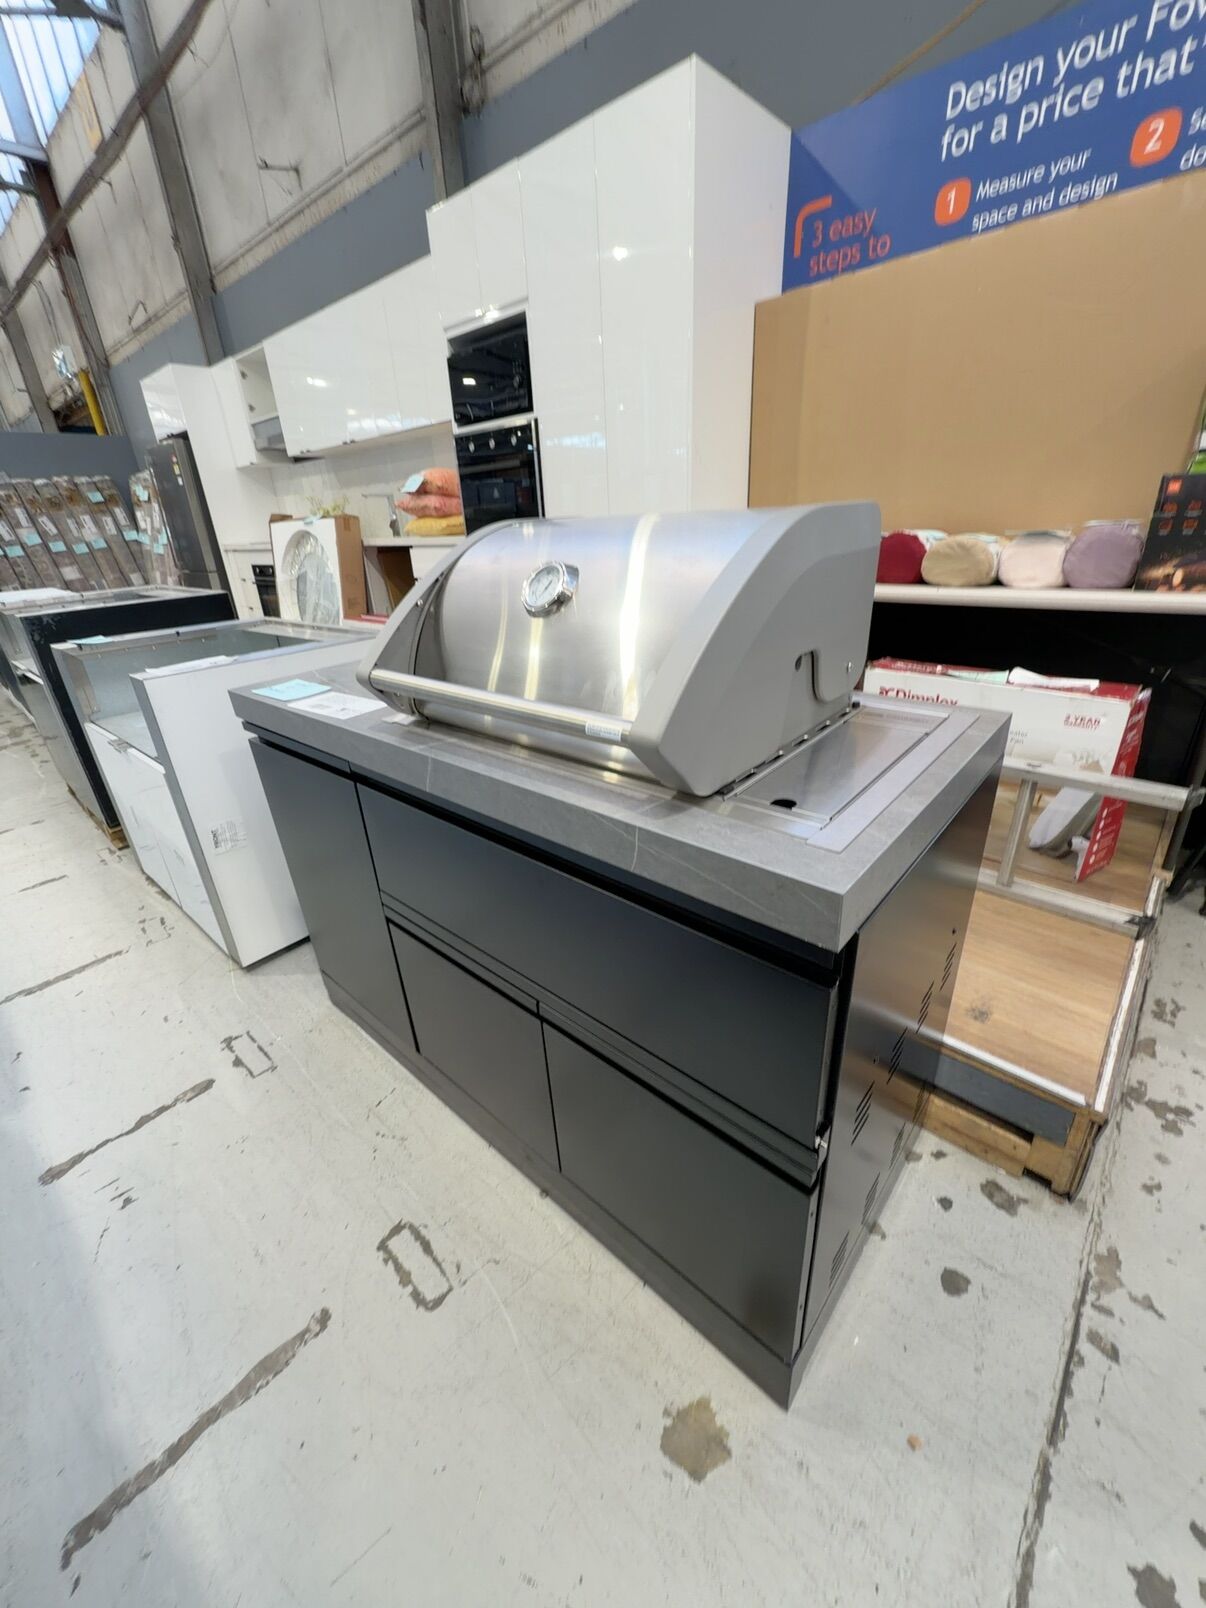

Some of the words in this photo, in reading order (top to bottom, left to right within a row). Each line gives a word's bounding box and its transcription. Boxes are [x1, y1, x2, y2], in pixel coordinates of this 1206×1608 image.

[945, 54, 1043, 120] Design
[1053, 14, 1138, 88] your
[940, 123, 982, 163] for
[990, 115, 1008, 144] a
[1017, 77, 1105, 144] price
[1116, 34, 1198, 99] that
[1143, 117, 1165, 155] 2
[976, 161, 1046, 203] Measure
[1050, 148, 1092, 179] your
[946, 189, 957, 214] 1
[971, 202, 1018, 235] space
[1022, 191, 1053, 217] and
[1059, 171, 1119, 206] design
[811, 222, 823, 247] 3
[829, 208, 876, 243] easy
[808, 249, 860, 277] steps
[868, 232, 891, 259] to
